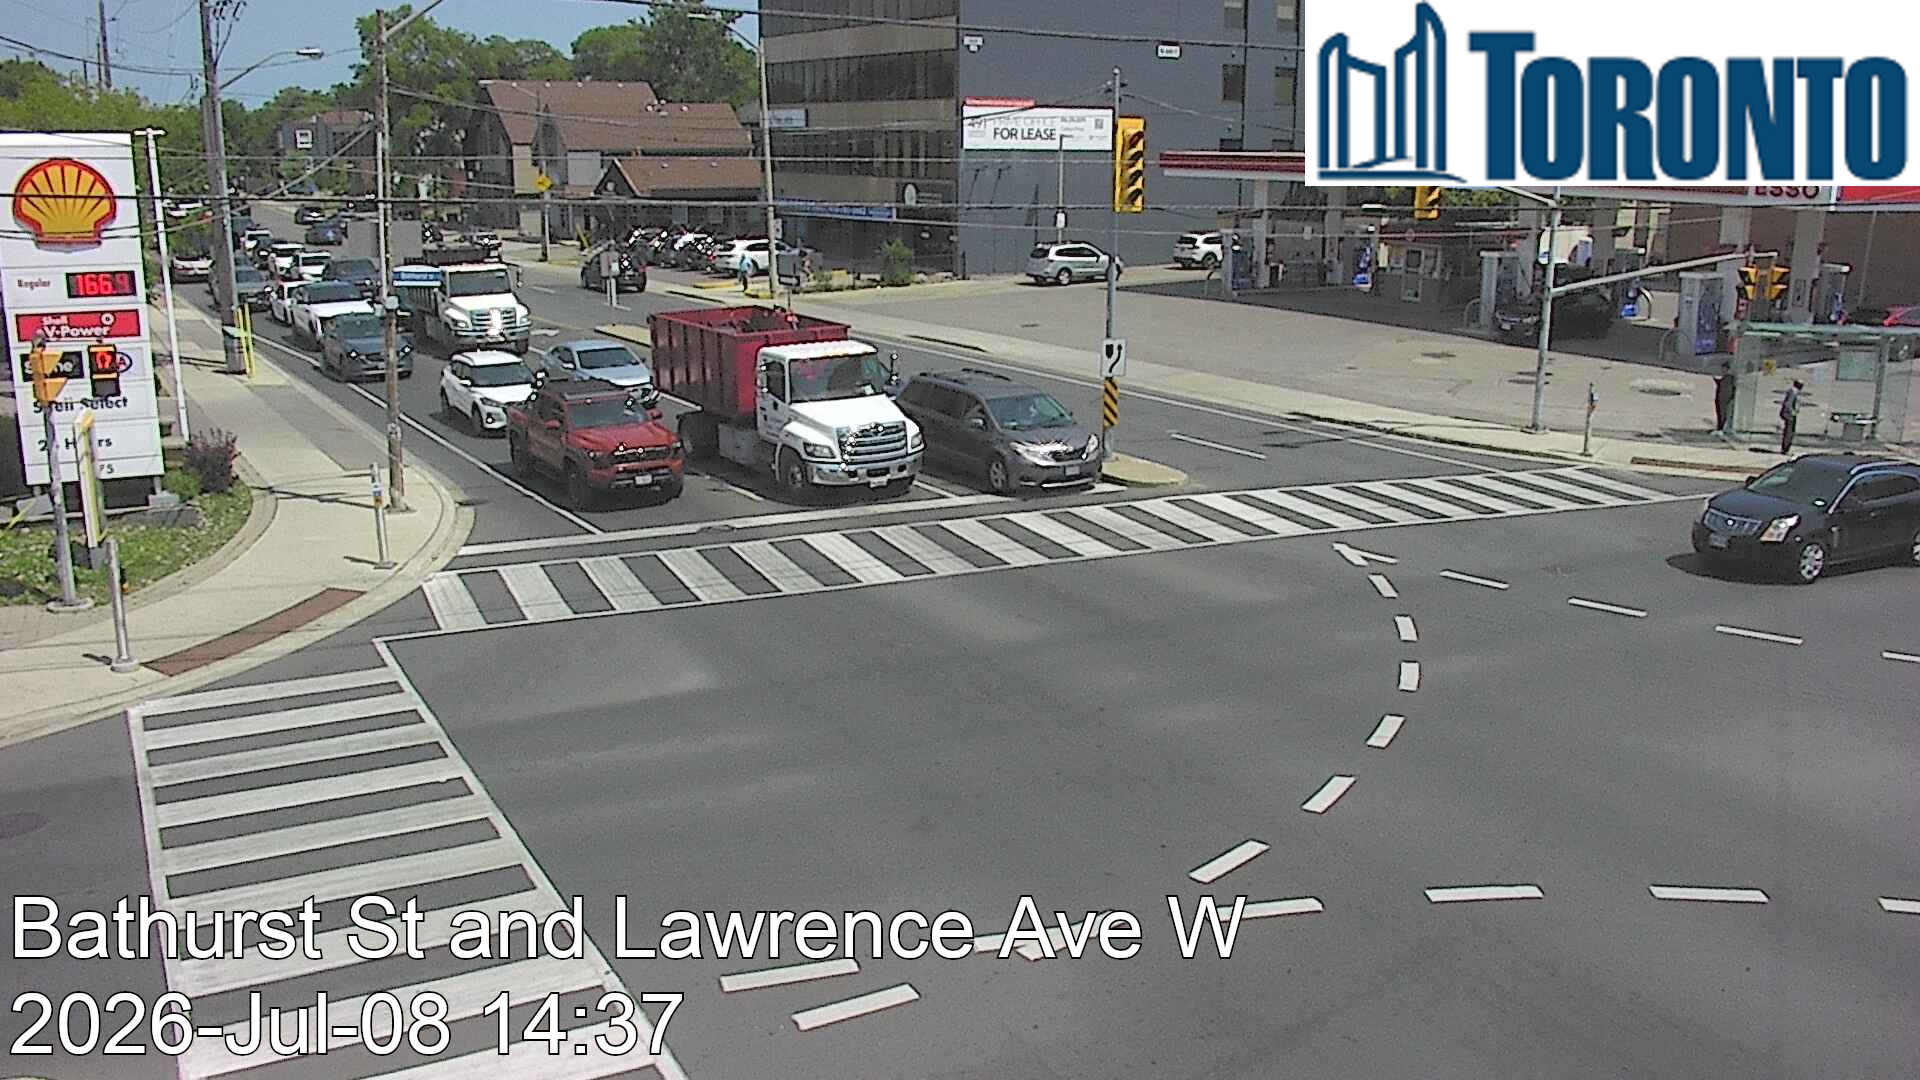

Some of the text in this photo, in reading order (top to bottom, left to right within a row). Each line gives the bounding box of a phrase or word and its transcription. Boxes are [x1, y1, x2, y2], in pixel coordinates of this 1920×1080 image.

[993, 127, 1056, 140] FOR LEASE
[42, 316, 69, 325] Shell
[33, 400, 75, 414] Sell
[65, 437, 112, 449] Hrs
